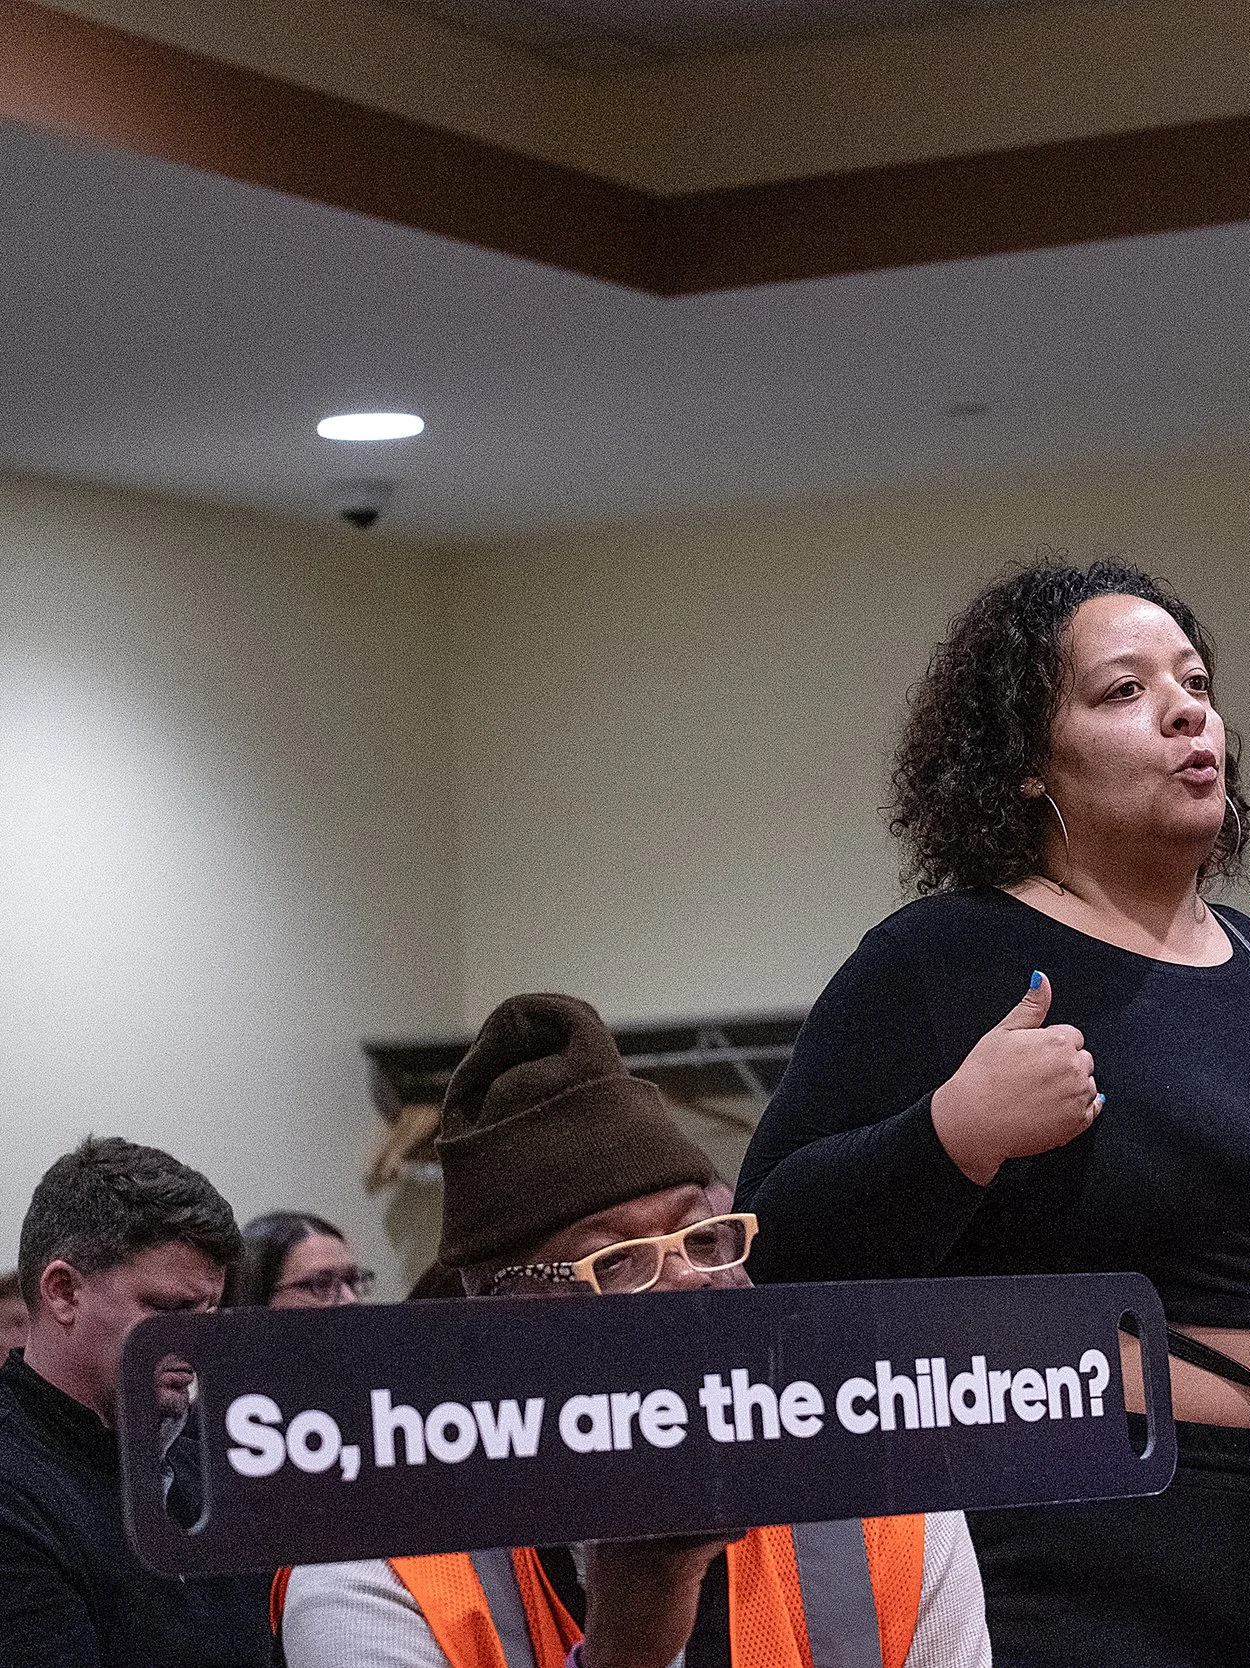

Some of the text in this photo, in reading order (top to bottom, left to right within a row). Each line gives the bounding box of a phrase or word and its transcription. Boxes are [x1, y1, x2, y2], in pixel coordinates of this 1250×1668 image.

[225, 1348, 1110, 1481] So, how are the children?
